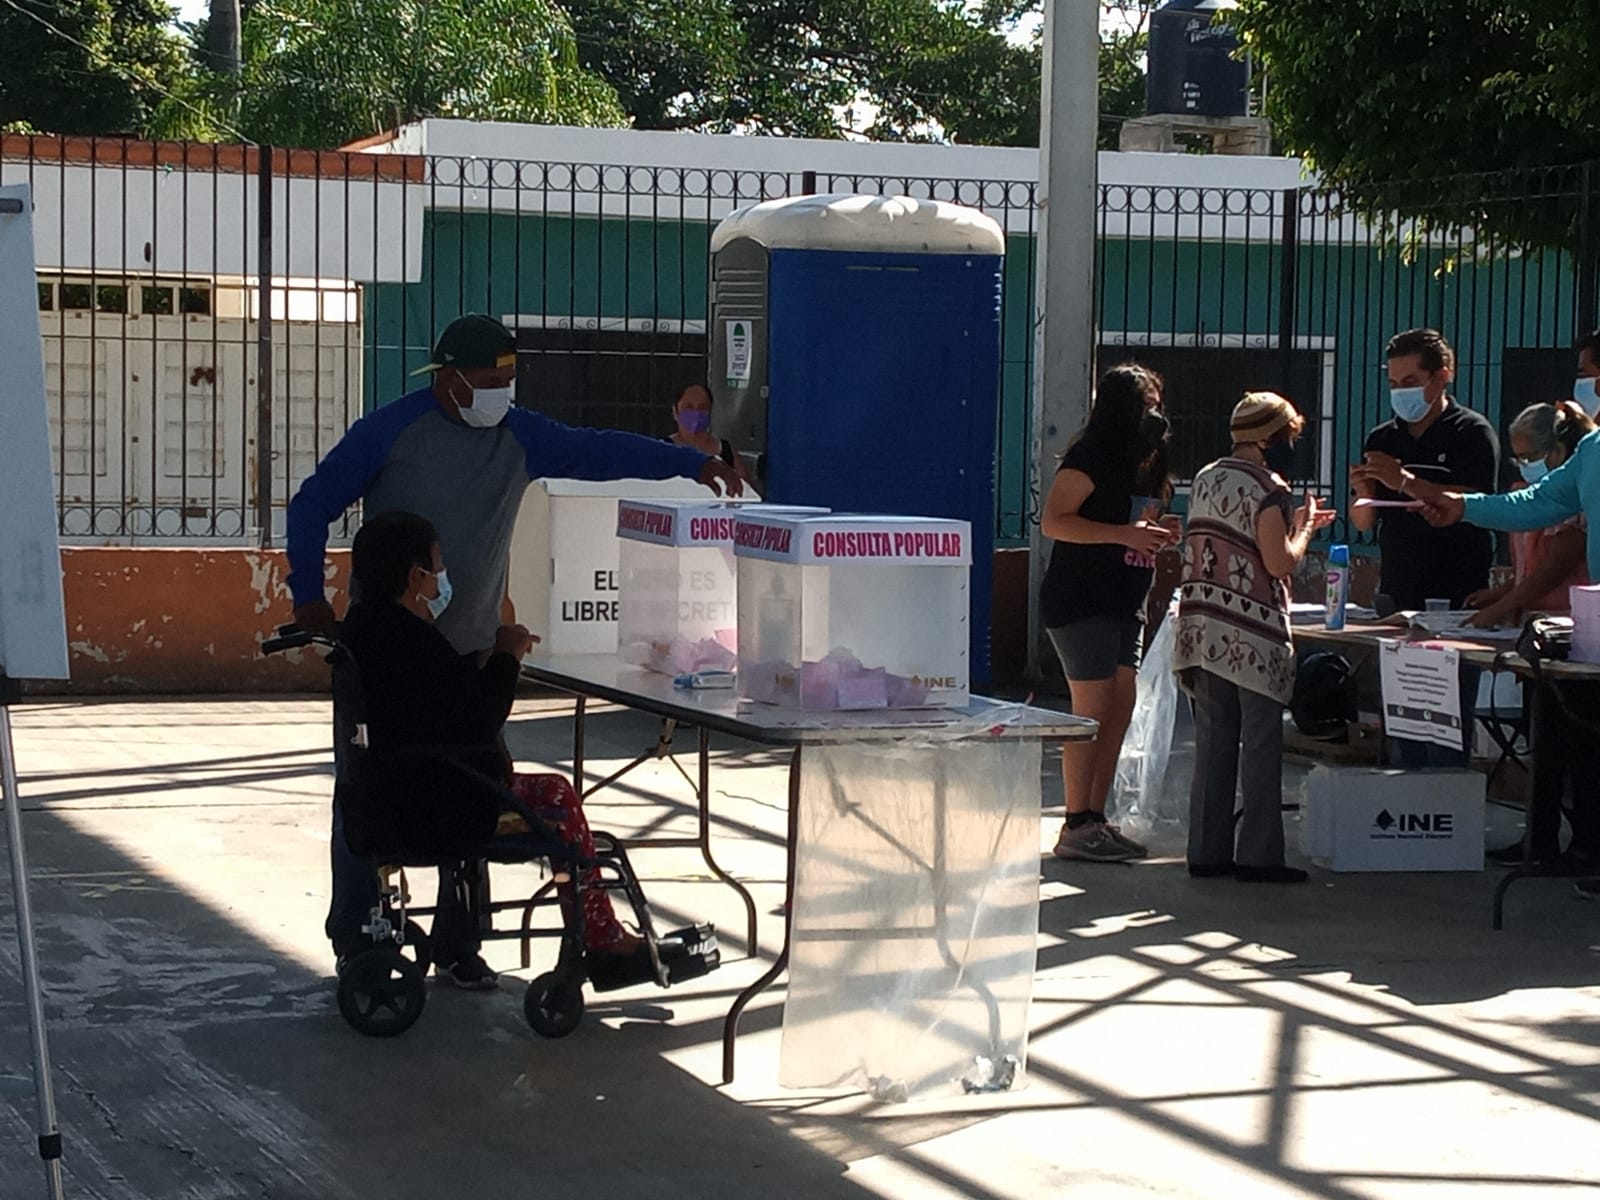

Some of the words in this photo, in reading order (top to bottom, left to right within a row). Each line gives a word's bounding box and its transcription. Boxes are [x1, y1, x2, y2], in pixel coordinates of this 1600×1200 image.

[813, 532, 892, 557] CONSULTA
[894, 532, 961, 557] POPULAR
[594, 571, 619, 591] EL
[562, 601, 619, 622] LIBRE
[924, 676, 957, 688] INE
[1400, 813, 1453, 832] INE
